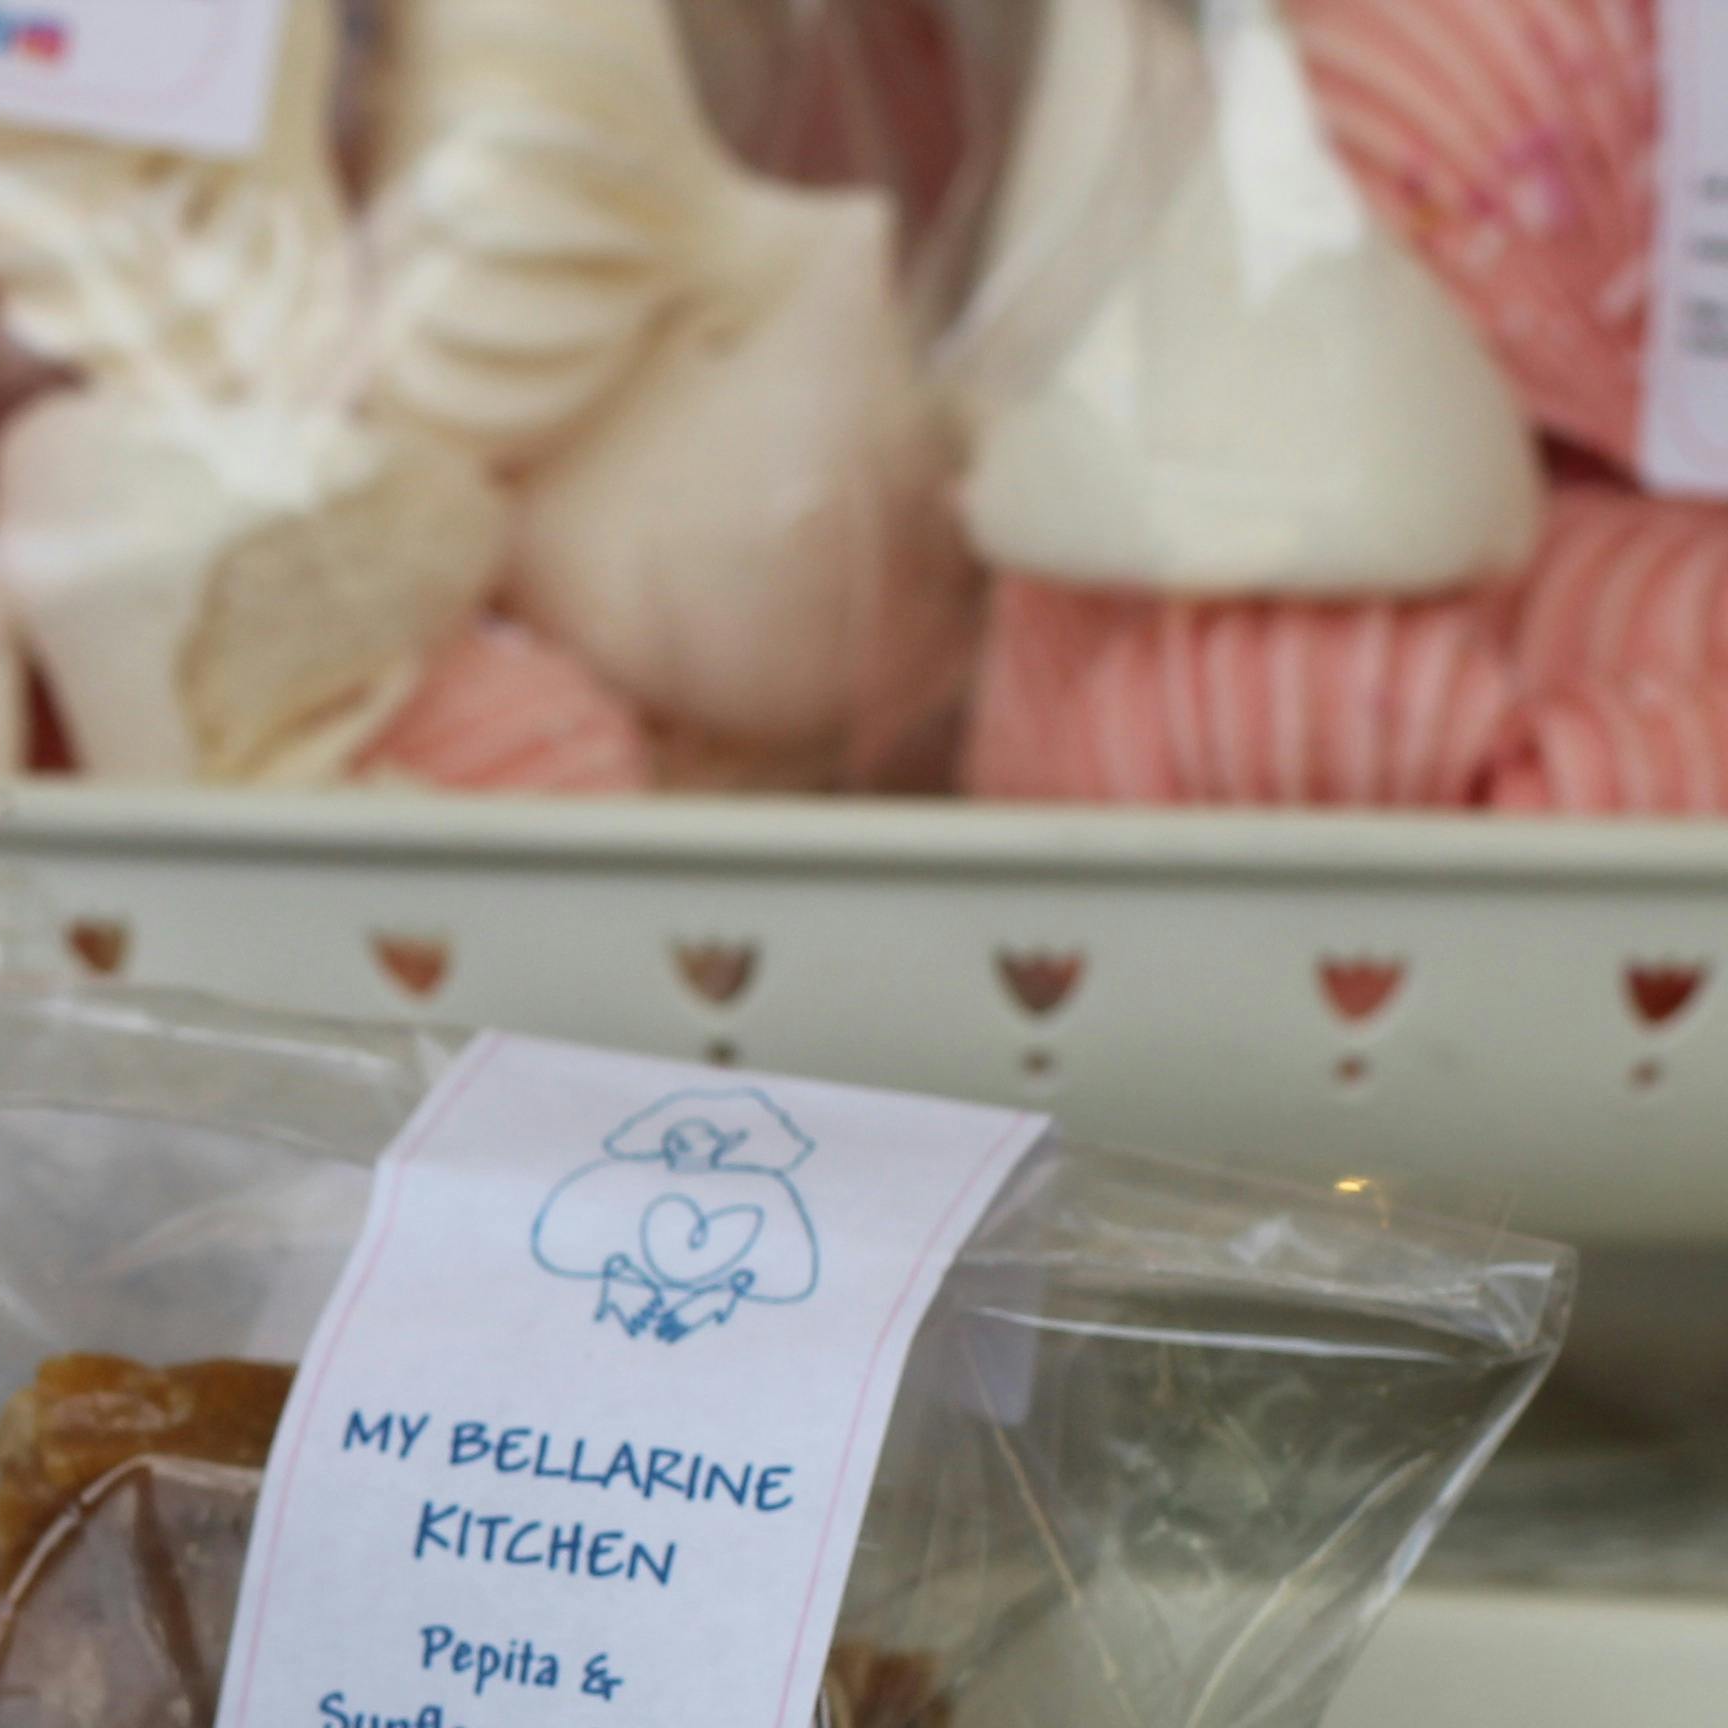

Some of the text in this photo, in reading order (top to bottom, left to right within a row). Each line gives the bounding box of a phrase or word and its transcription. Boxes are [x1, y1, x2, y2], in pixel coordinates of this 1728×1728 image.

[344, 1411, 793, 1512] MY BELLARINE
[414, 1501, 676, 1585] KITCHEN
[421, 1625, 623, 1701] Pepita &
